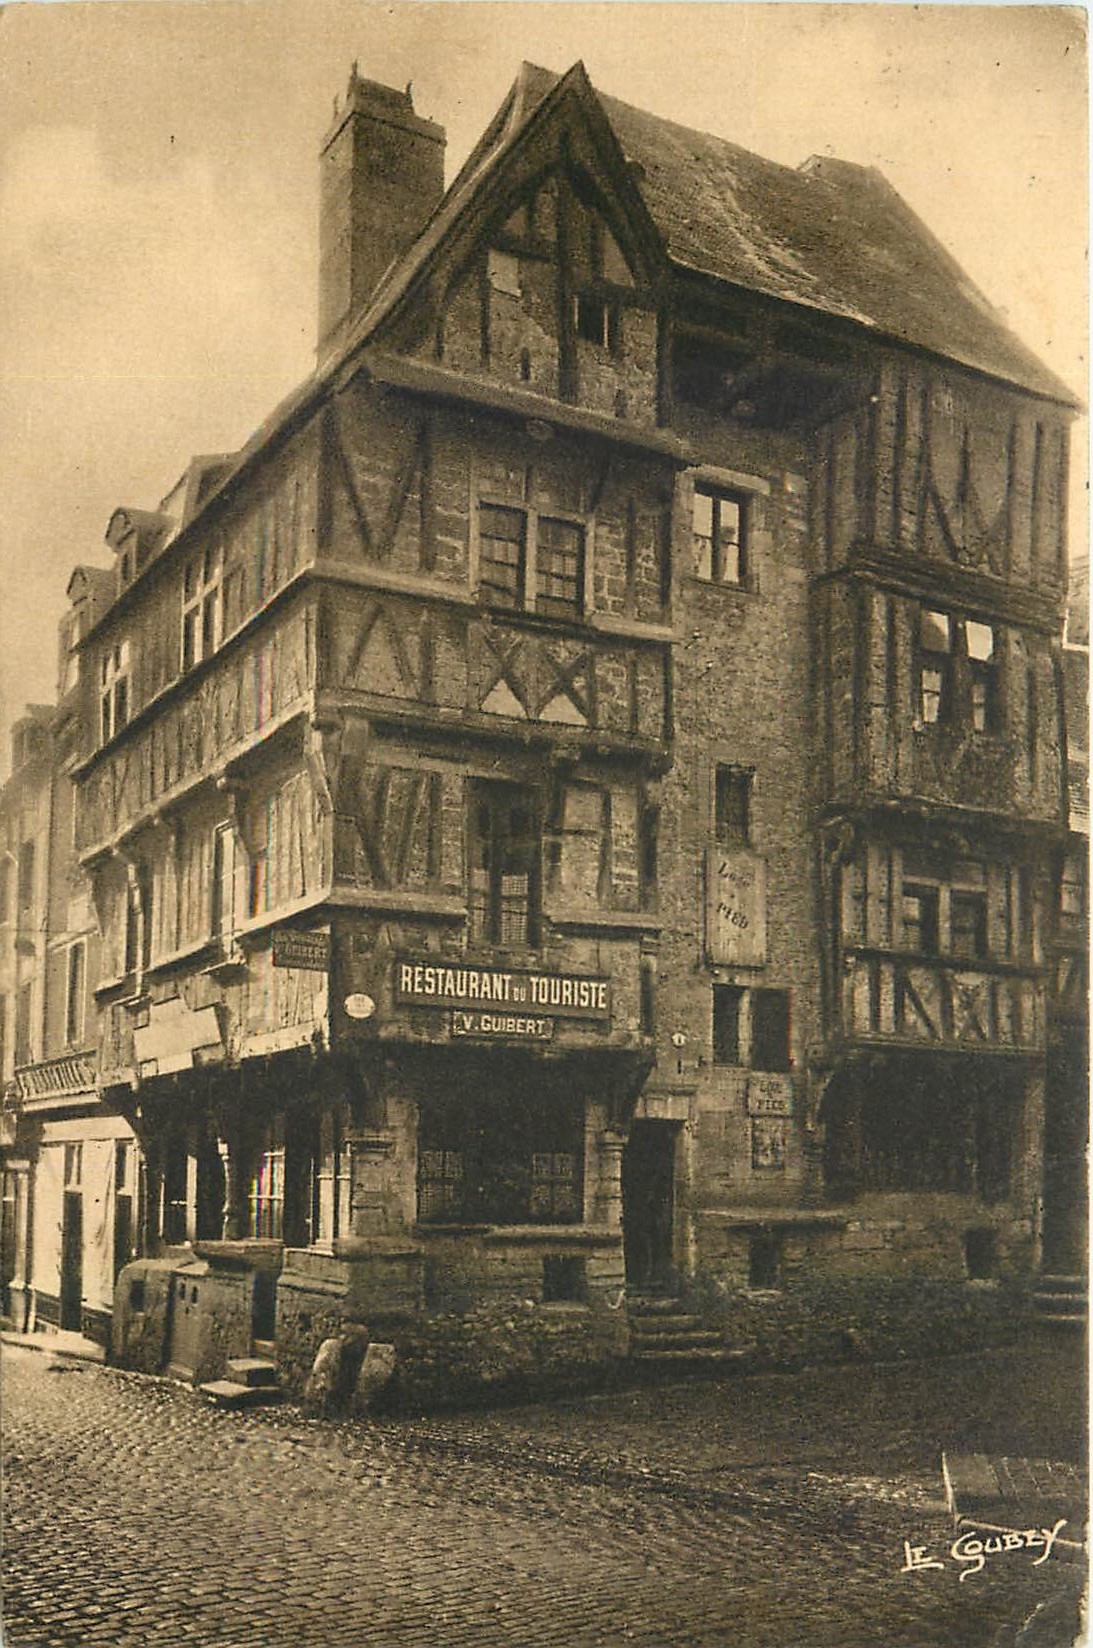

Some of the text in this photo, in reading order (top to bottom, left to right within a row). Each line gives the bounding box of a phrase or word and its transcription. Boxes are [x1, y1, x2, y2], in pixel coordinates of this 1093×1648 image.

[401, 964, 607, 1009] RESTAURANT DU TOURISTE
[462, 1015, 545, 1035] V. GUIBERT
